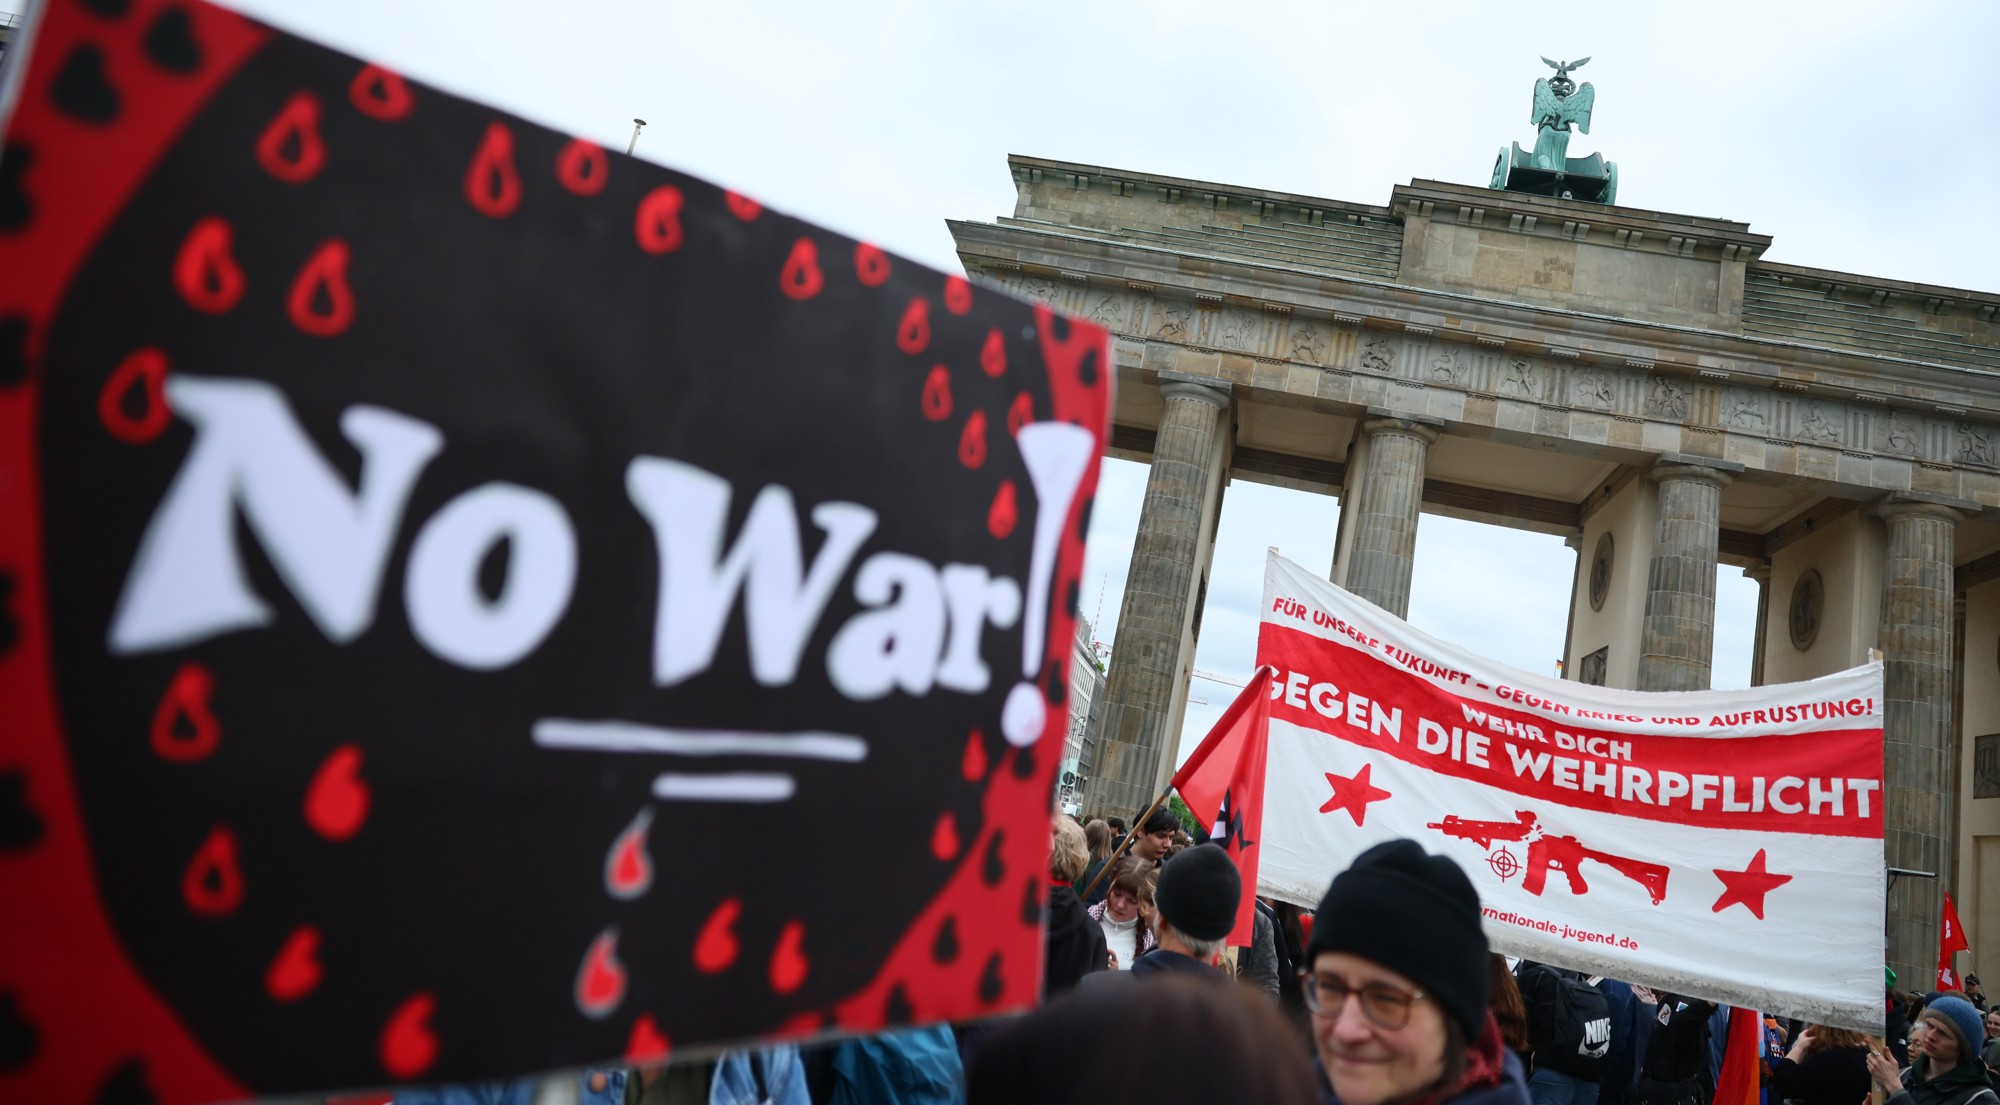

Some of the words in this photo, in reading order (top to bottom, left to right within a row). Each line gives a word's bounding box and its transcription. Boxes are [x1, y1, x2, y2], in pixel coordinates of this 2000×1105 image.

[106, 374, 578, 671] No
[624, 421, 1096, 747] War!
[1273, 597, 1307, 620] FÜR
[1312, 609, 1379, 649] UNSERE
[1385, 645, 1471, 685] ZUKUNFT
[1495, 684, 1570, 717] GEGEN
[1576, 708, 1645, 724] KRIEG
[1651, 716, 1701, 727] UND
[1708, 697, 1874, 727] AUFRÜSTUNG!
[1417, 718, 1491, 769] DIE
[1504, 742, 1879, 818] WEHRPFLICHT
[1461, 703, 1549, 743] WEHR
[1556, 732, 1632, 761] DICH
